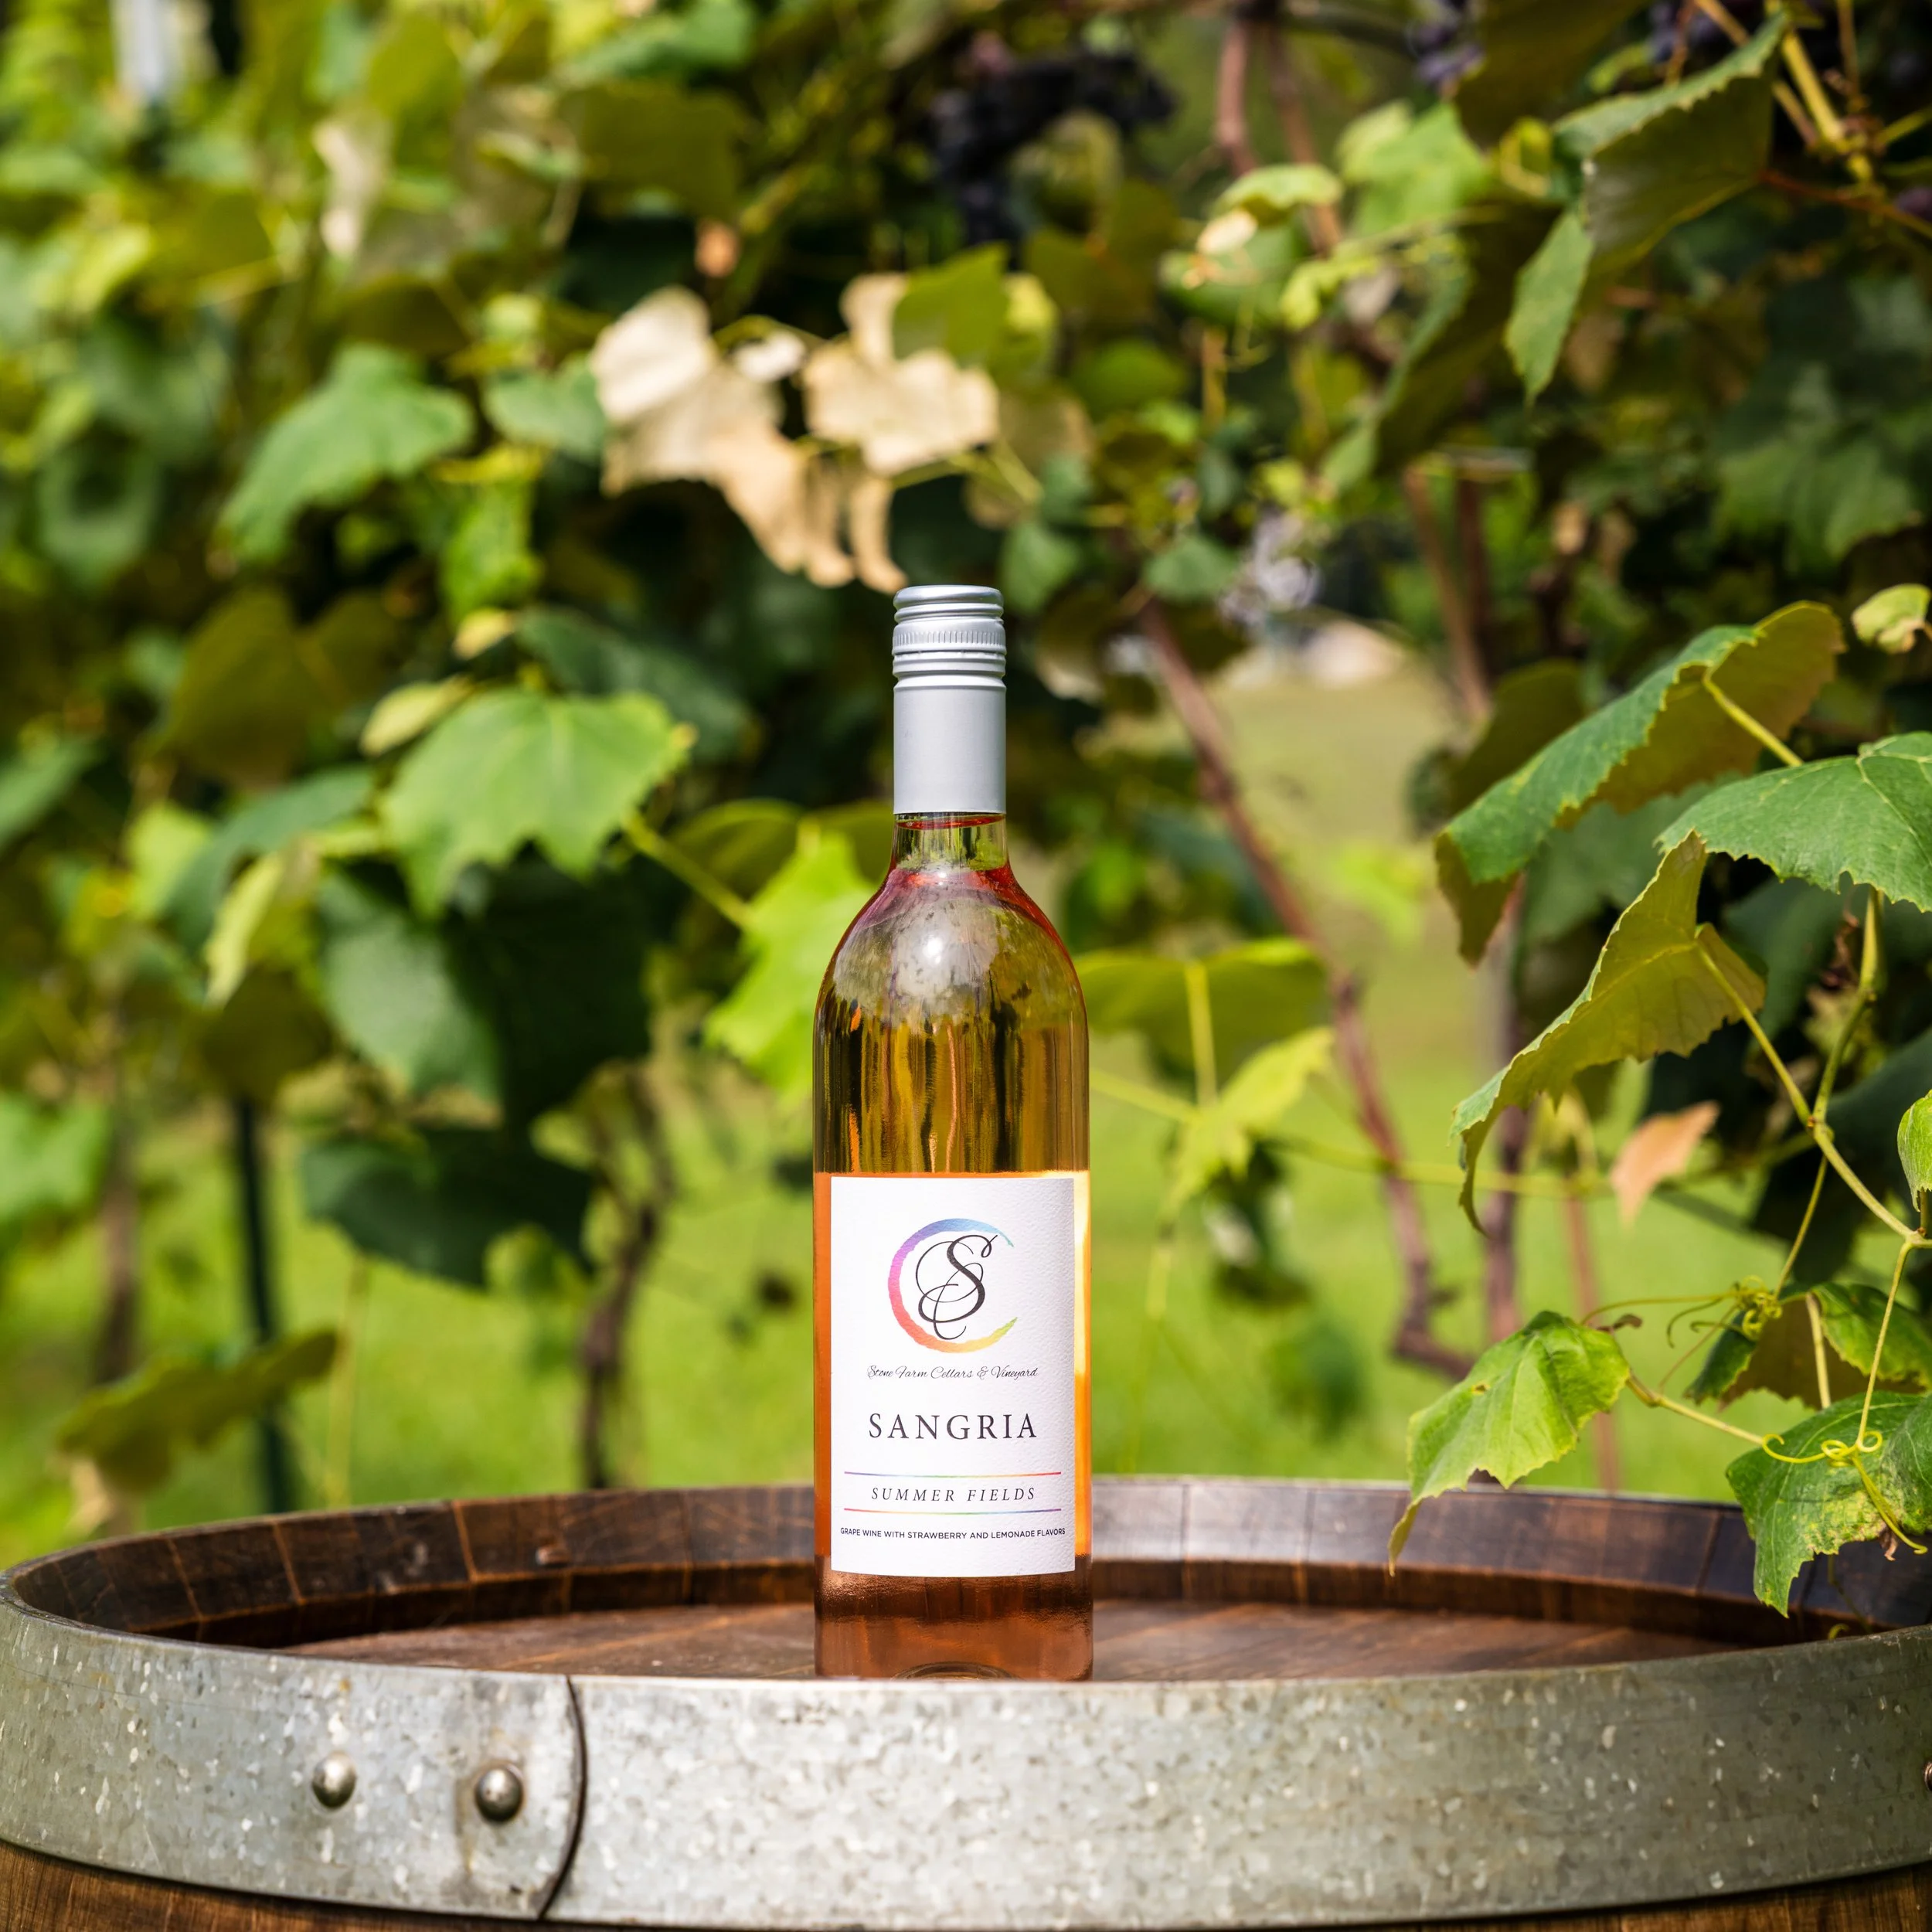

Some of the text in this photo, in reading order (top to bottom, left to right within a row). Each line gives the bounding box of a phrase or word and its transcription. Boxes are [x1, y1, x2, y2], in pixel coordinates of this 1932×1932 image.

[867, 1366, 1038, 1380] Stone Farm Cellars & Vineyard
[869, 1413, 1037, 1440] SANGRIA
[871, 1487, 1035, 1502] SUMMER FIELDS
[840, 1527, 861, 1536] GRAPE
[862, 1529, 882, 1538] WINE
[883, 1530, 905, 1539] WITH
[907, 1531, 968, 1539] STRAWBERRY
[991, 1529, 1036, 1539] LEMONADE
[1036, 1527, 1066, 1537] FLAVORS
